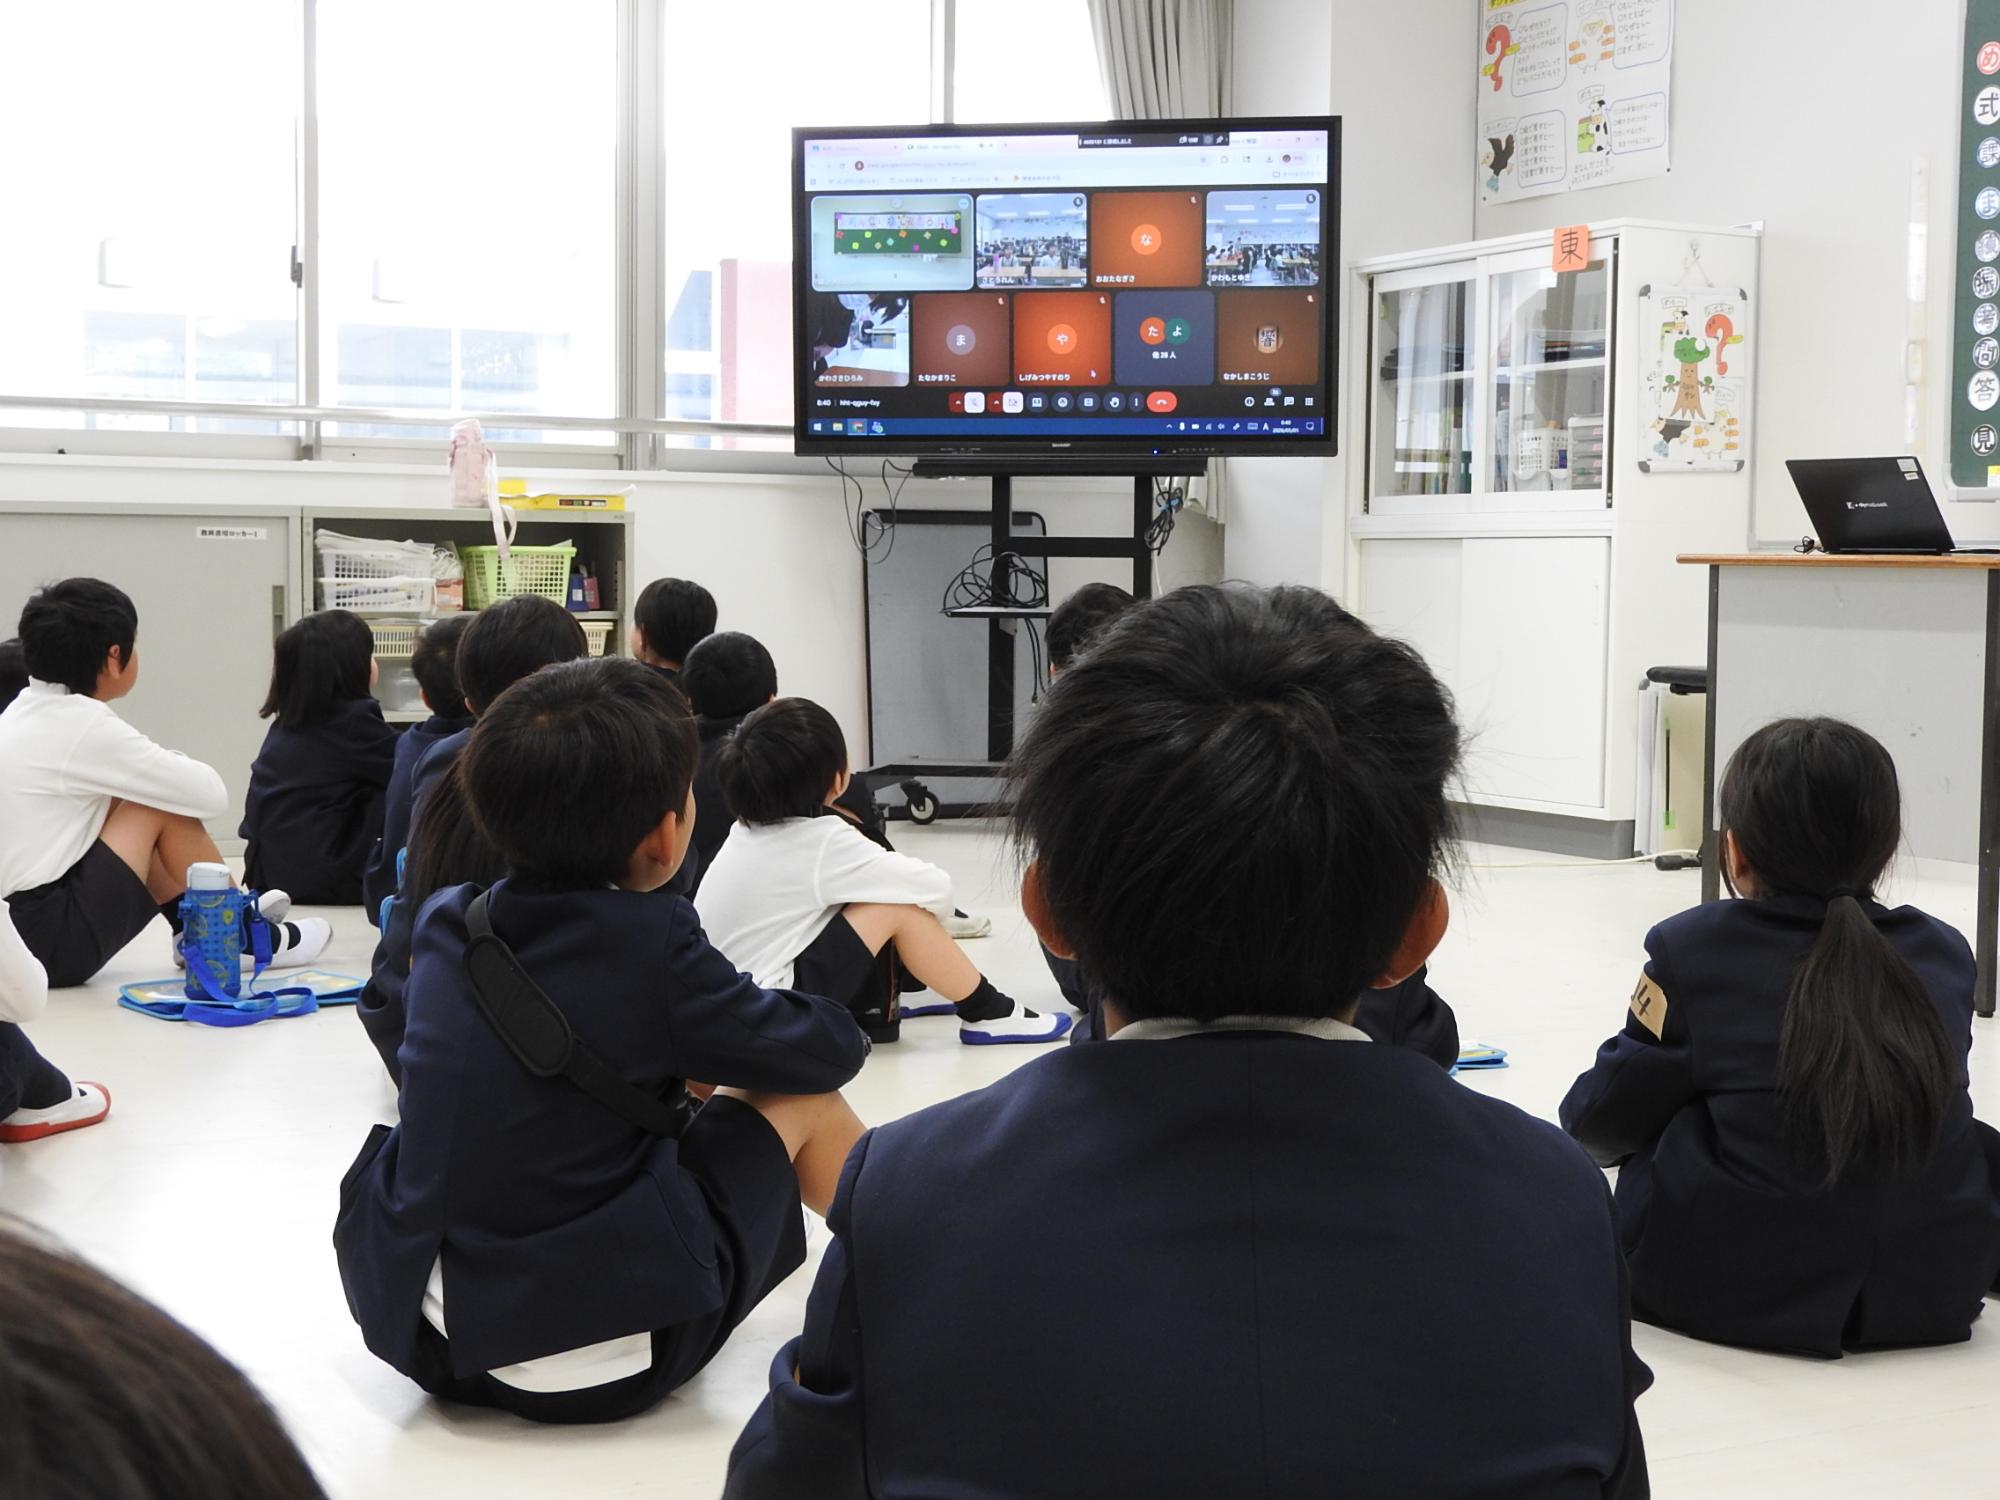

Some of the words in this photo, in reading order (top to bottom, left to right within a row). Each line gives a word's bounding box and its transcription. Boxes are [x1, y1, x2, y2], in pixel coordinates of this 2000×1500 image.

[1981, 47, 1999, 68] め
[1978, 92, 1999, 117] 式
[1981, 190, 1998, 213] ま
[1140, 234, 1152, 246] な
[1558, 228, 1584, 265] 東
[956, 334, 967, 346] ま
[1056, 333, 1069, 346] や
[1148, 326, 1159, 337] た
[1172, 325, 1183, 337] よ
[1974, 376, 1996, 403] 答
[1975, 427, 1995, 453] 見
